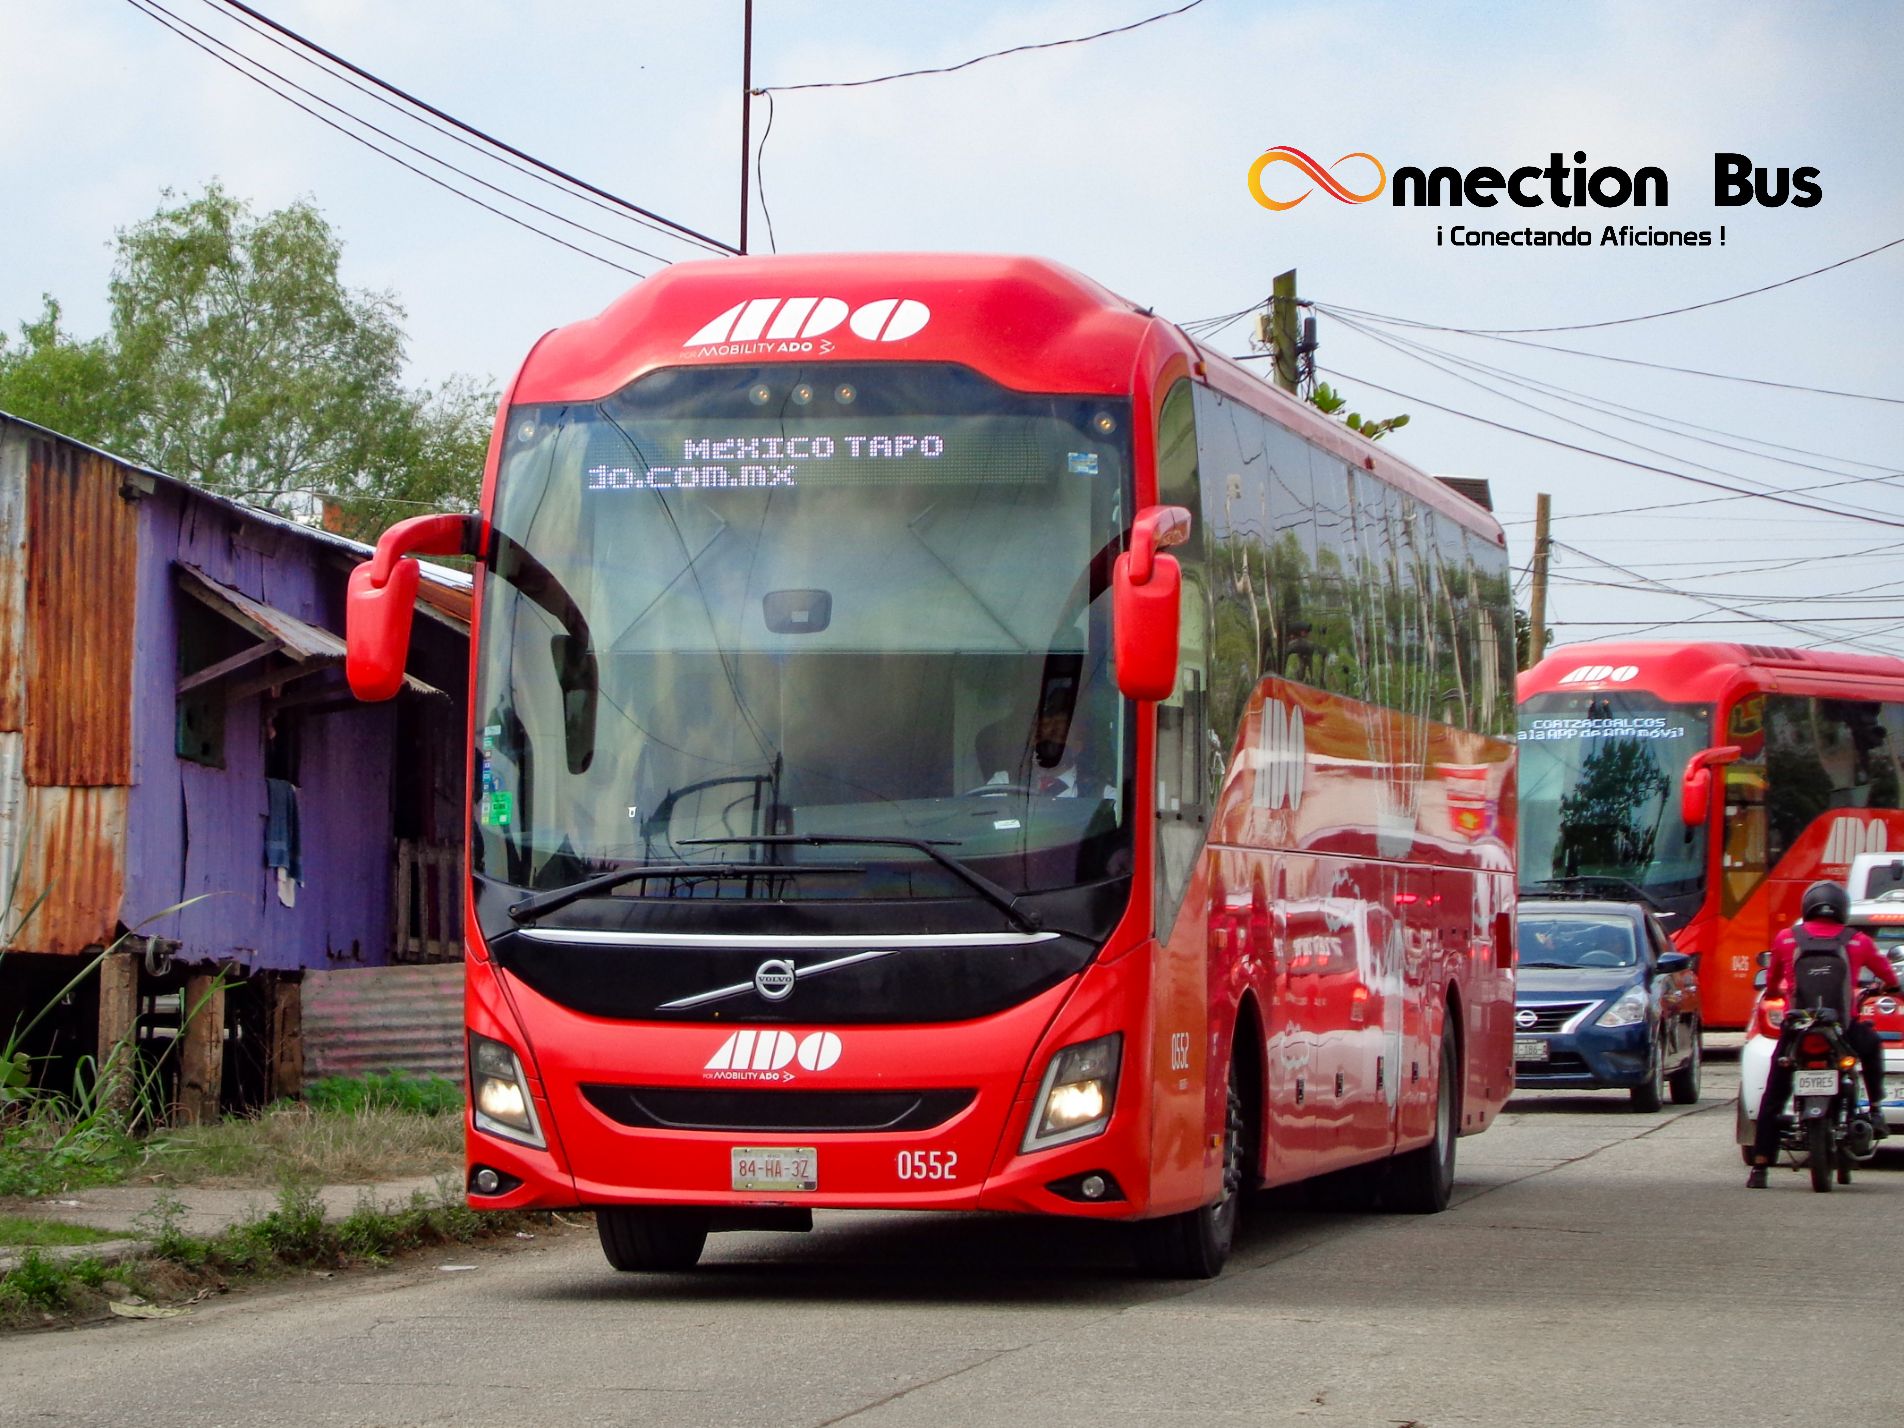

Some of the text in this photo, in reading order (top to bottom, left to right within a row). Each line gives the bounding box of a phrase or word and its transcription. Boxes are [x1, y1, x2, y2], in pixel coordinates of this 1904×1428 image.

[682, 296, 931, 348] ADO
[697, 342, 775, 359] MOBILITY
[776, 341, 813, 354] ADO
[844, 434, 944, 458] TAPO
[1558, 665, 1640, 684] ADO
[1533, 717, 1667, 730] COATZACOALCOS
[758, 975, 793, 983] VOLVO
[703, 1030, 843, 1072] ADO
[713, 1071, 757, 1081] MOBILITY
[758, 1071, 781, 1081] ADO
[897, 1150, 958, 1180] 0552
